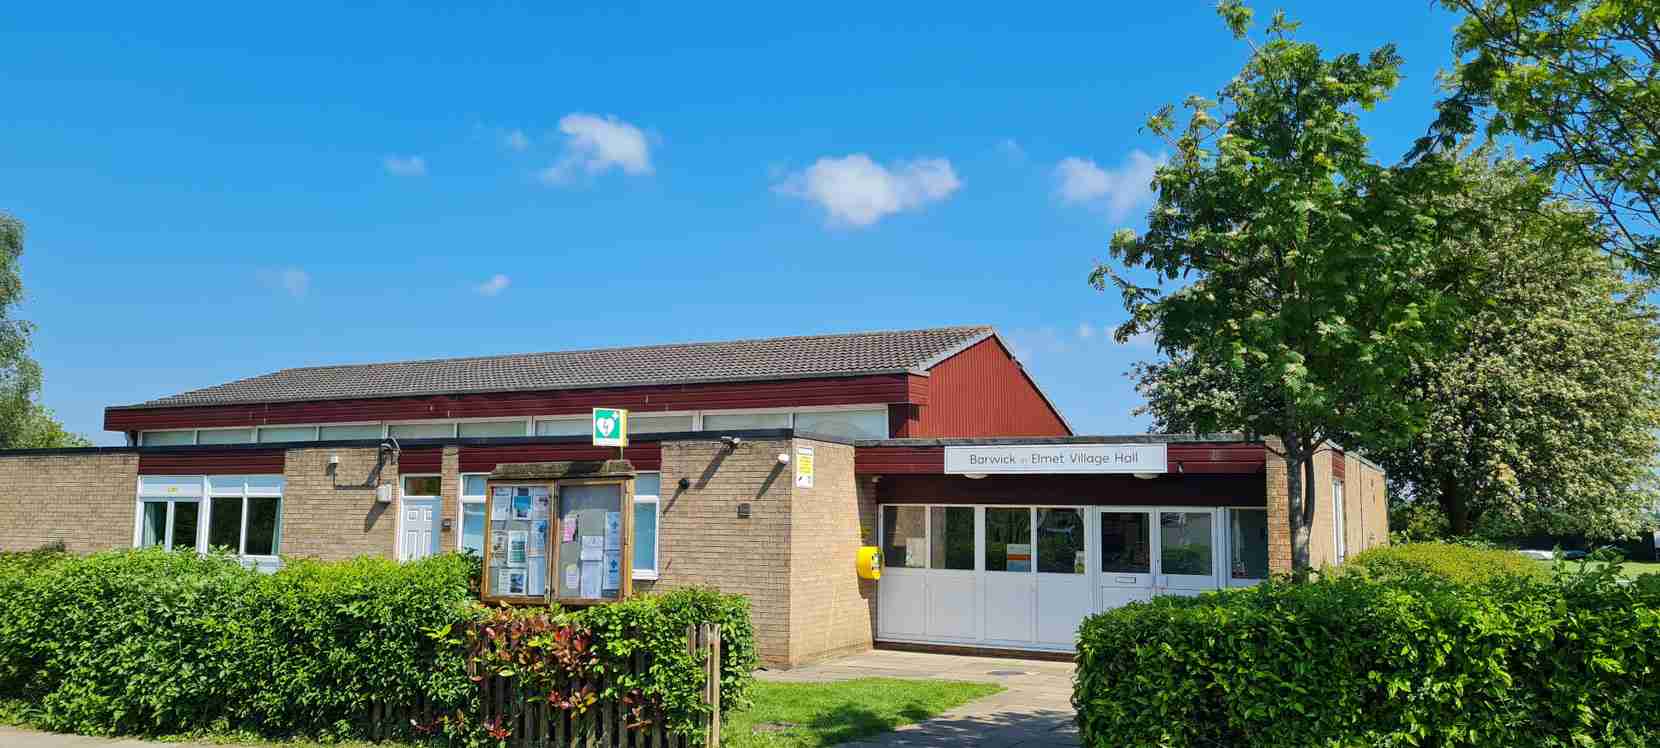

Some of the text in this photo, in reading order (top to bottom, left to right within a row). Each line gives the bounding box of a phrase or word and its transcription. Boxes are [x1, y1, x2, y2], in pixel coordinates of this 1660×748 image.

[970, 454, 1016, 465] Barwick
[1031, 453, 1064, 464] Elmet
[1070, 453, 1110, 466] Village
[1114, 452, 1138, 464] Hall
